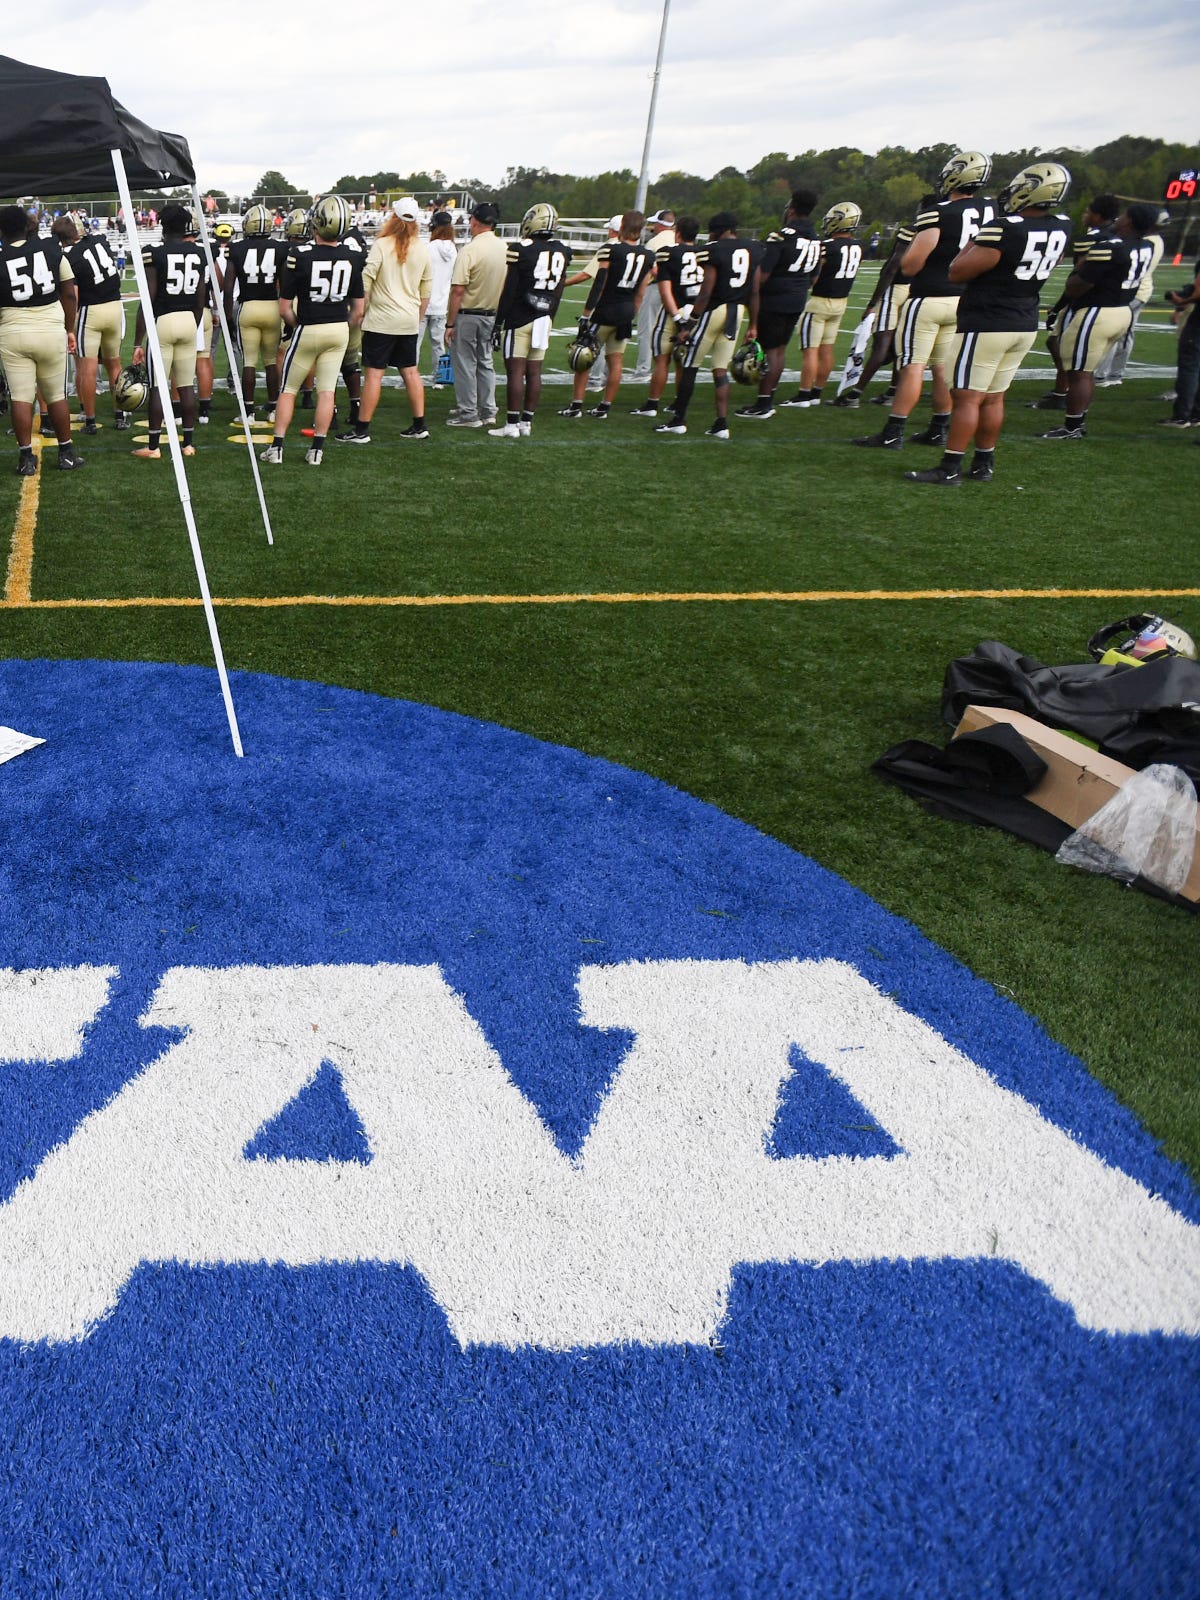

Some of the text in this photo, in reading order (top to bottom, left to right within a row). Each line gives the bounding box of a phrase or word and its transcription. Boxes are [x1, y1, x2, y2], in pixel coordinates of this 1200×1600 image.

[1166, 179, 1196, 199] 09
[82, 242, 117, 285] 14
[166, 253, 200, 295] 56
[243, 248, 277, 284] 44
[533, 250, 565, 290] 49
[617, 252, 646, 289] 11
[729, 248, 750, 288] 9
[788, 237, 821, 273] 70
[834, 244, 863, 279] 18
[1014, 230, 1067, 281] 58
[1121, 246, 1153, 290] 17
[5, 250, 56, 302] 54
[309, 260, 352, 303] 50
